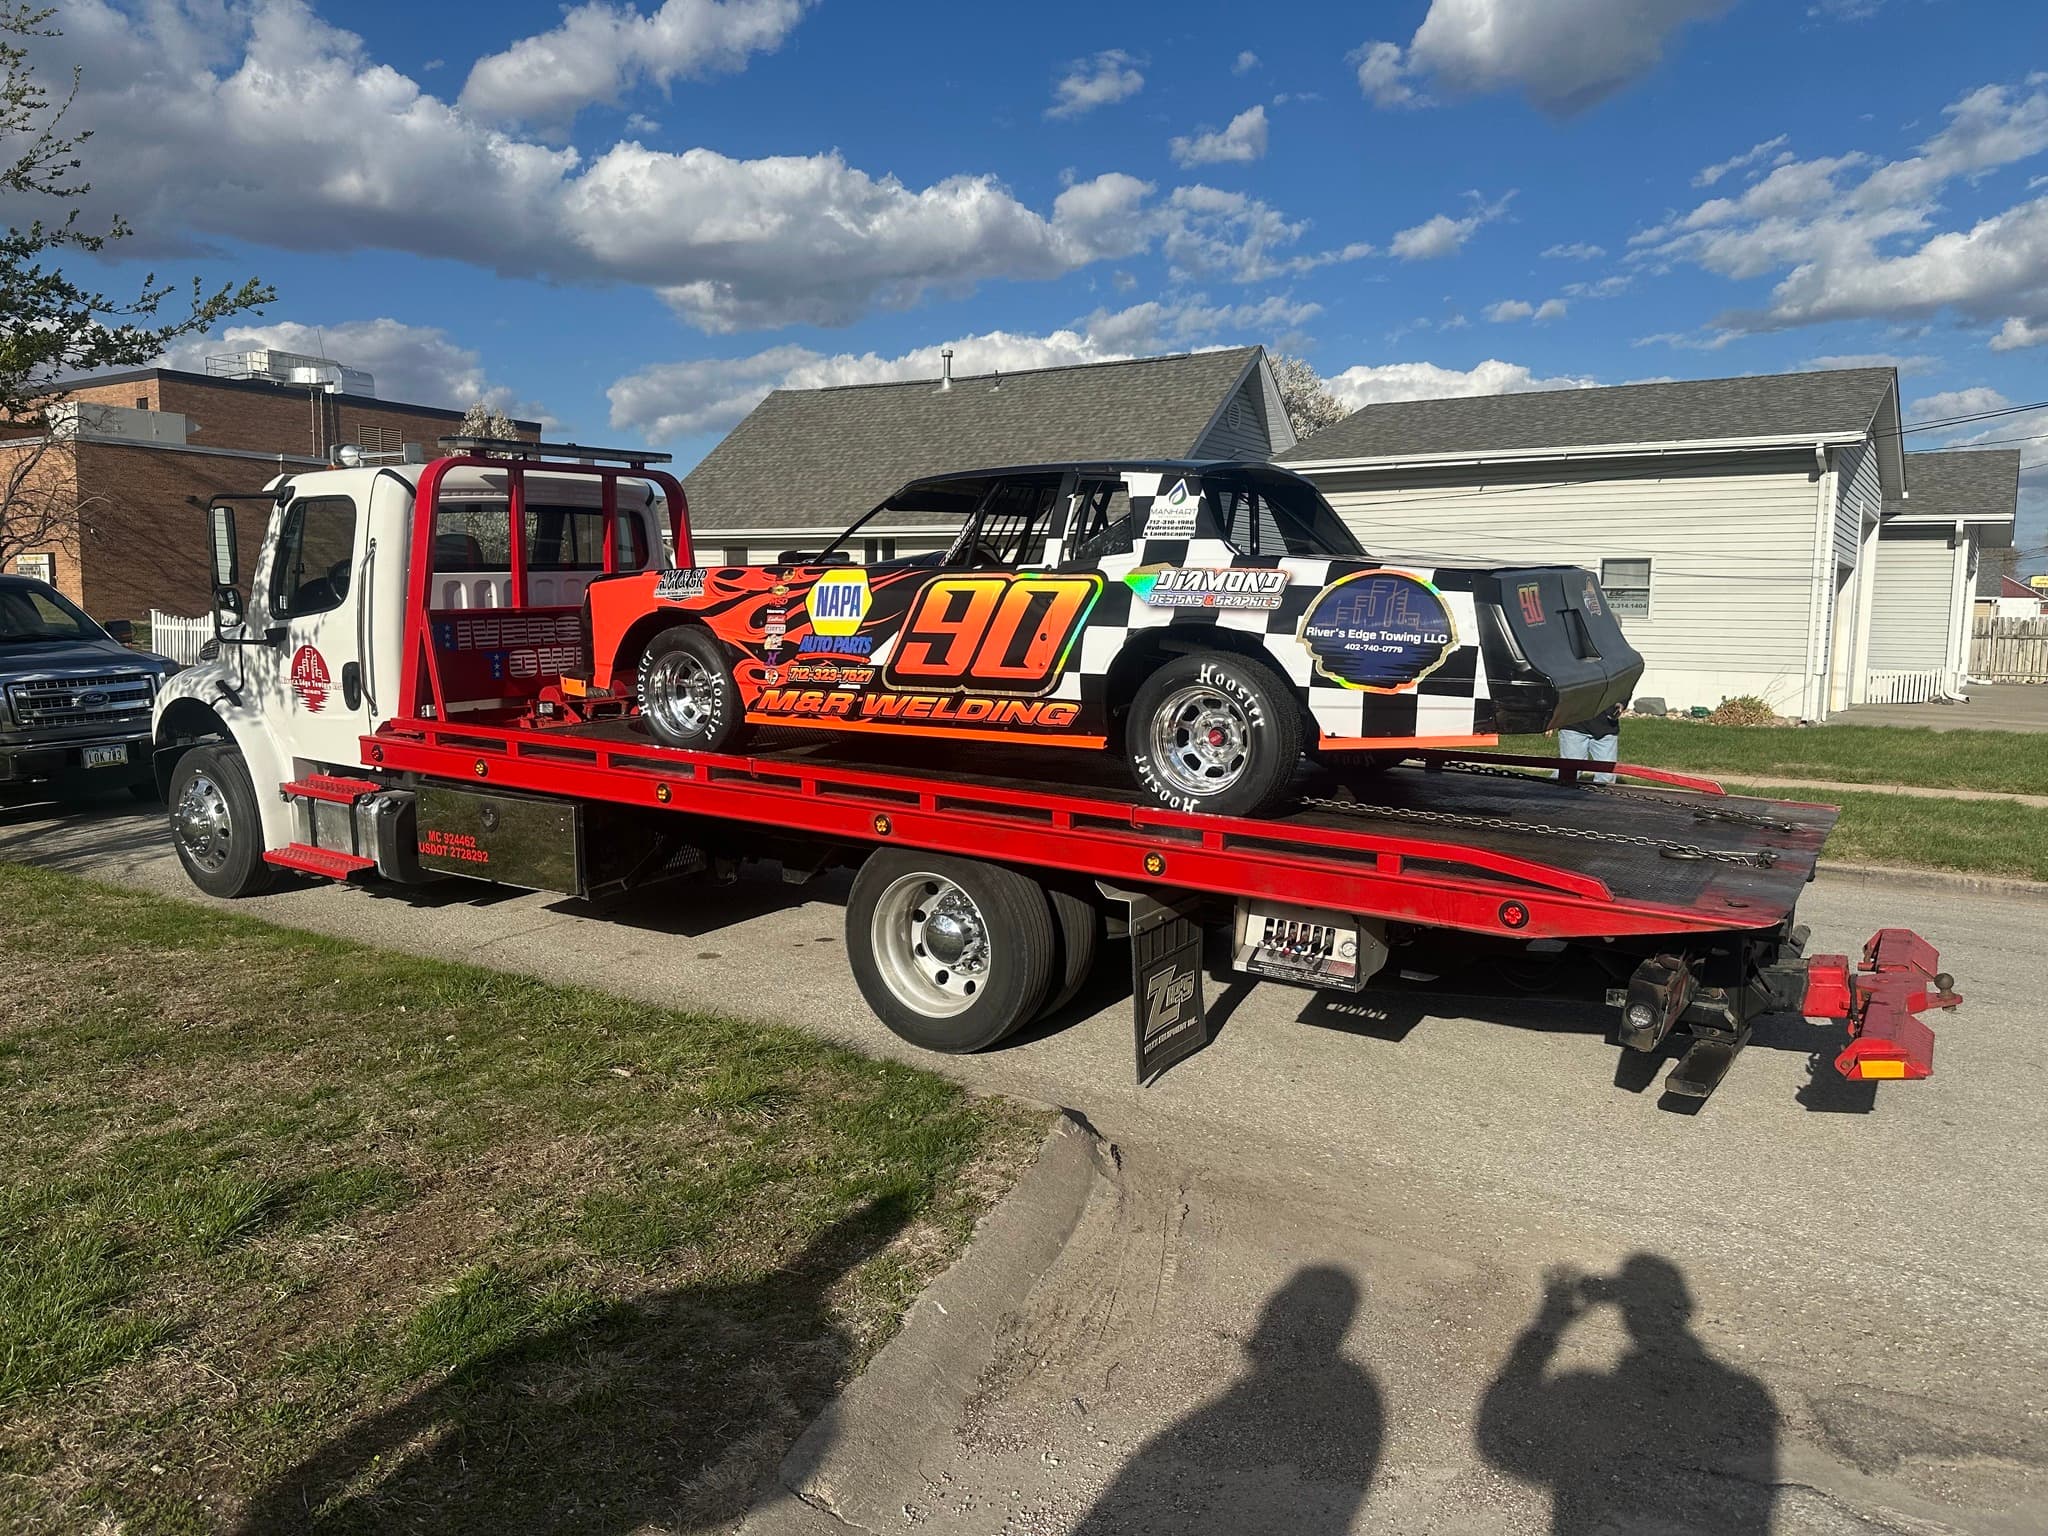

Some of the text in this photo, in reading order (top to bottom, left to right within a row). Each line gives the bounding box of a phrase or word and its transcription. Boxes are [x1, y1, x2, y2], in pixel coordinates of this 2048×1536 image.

[815, 585, 862, 617] NAPA
[1518, 585, 1546, 626] 90
[798, 635, 834, 653] AUTO
[833, 636, 873, 654] PARTS
[894, 579, 1092, 680] 90
[1305, 626, 1448, 644] River's Edge Towing LLC
[1344, 642, 1403, 653] 402-740-0779
[637, 650, 653, 717] Hoosier
[1195, 663, 1265, 728] Hoosier
[705, 672, 726, 741] Hoosier
[756, 689, 1081, 726] M&R WELDING
[1134, 755, 1201, 813] Hoosier
[418, 842, 489, 863] USDOT 2728292
[428, 830, 476, 848] MC 924462
